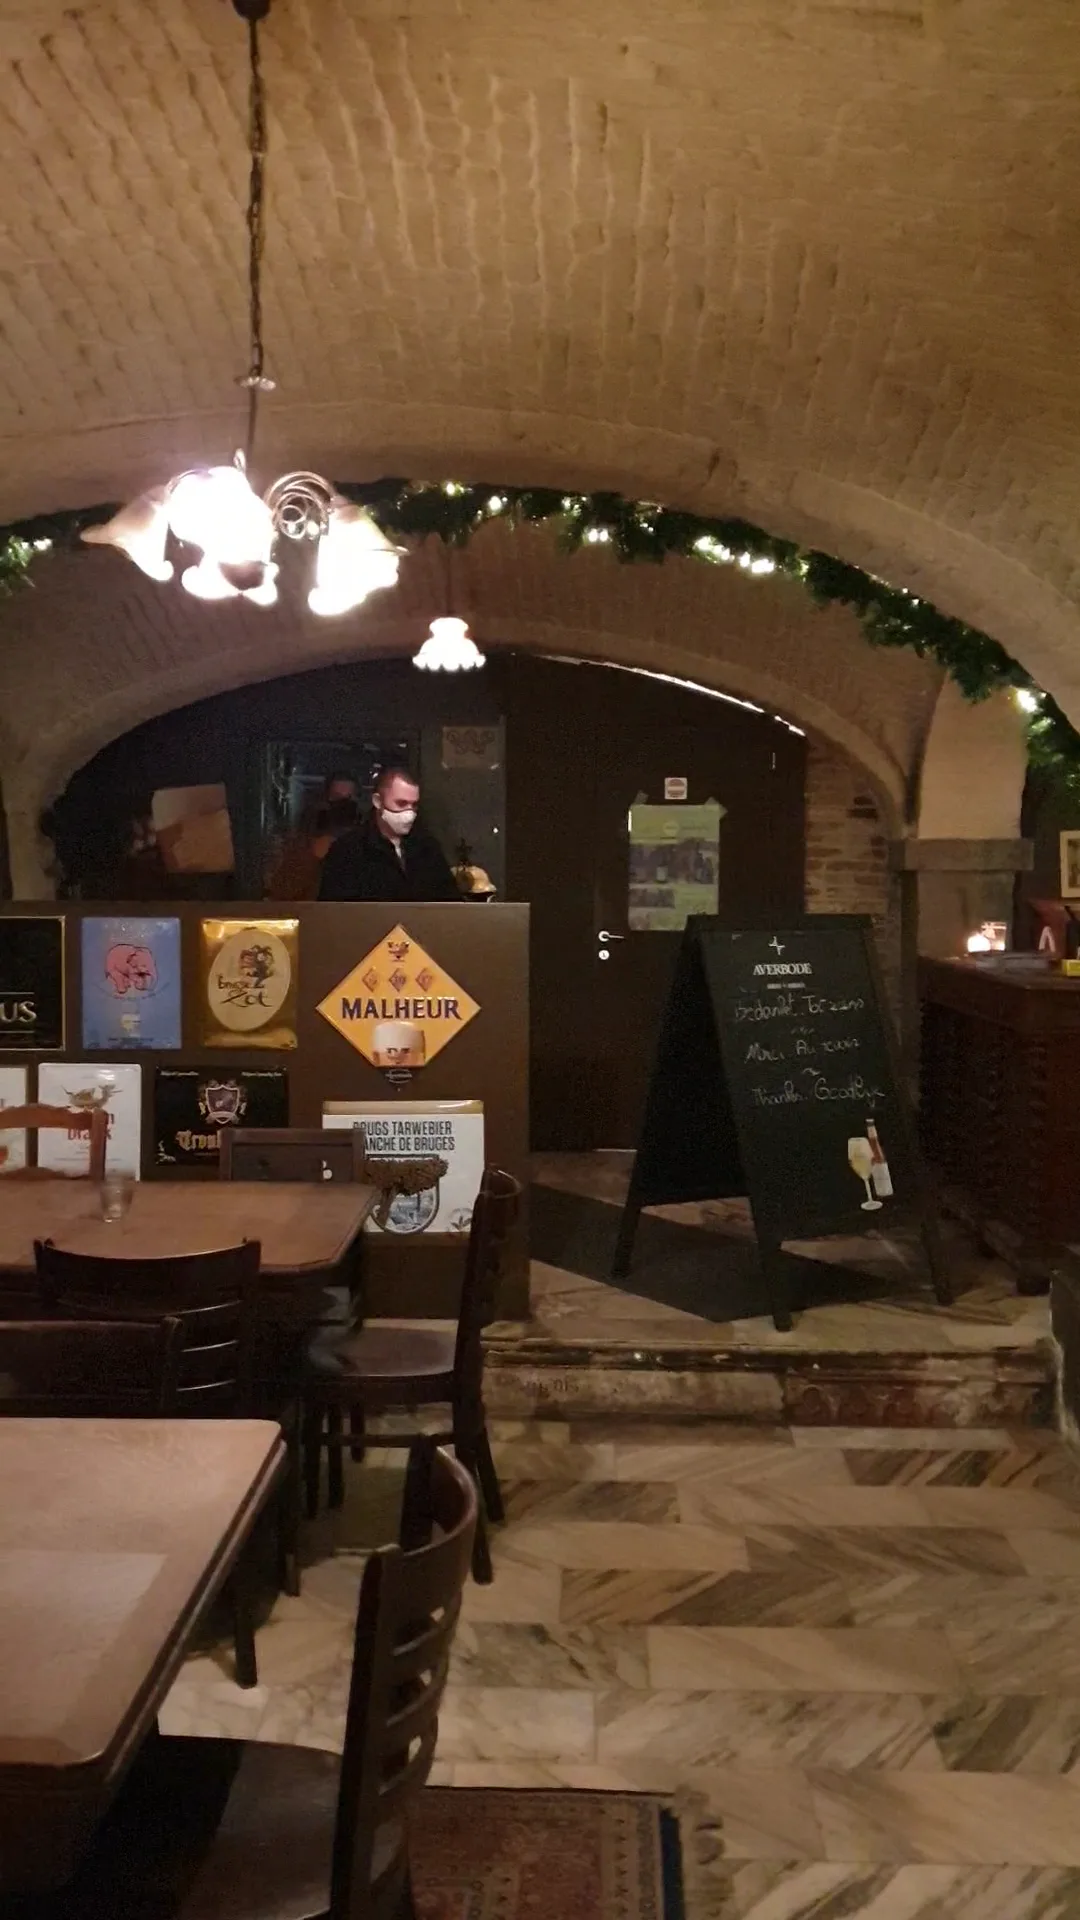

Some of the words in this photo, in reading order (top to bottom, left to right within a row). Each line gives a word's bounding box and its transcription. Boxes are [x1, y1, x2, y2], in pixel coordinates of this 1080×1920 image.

[753, 963, 814, 976] AVERBODE
[341, 996, 462, 1021] MALHEUR
[392, 1120, 452, 1135] TARWEBIER
[399, 1136, 412, 1151] DE
[414, 1136, 456, 1152] BRUGES
